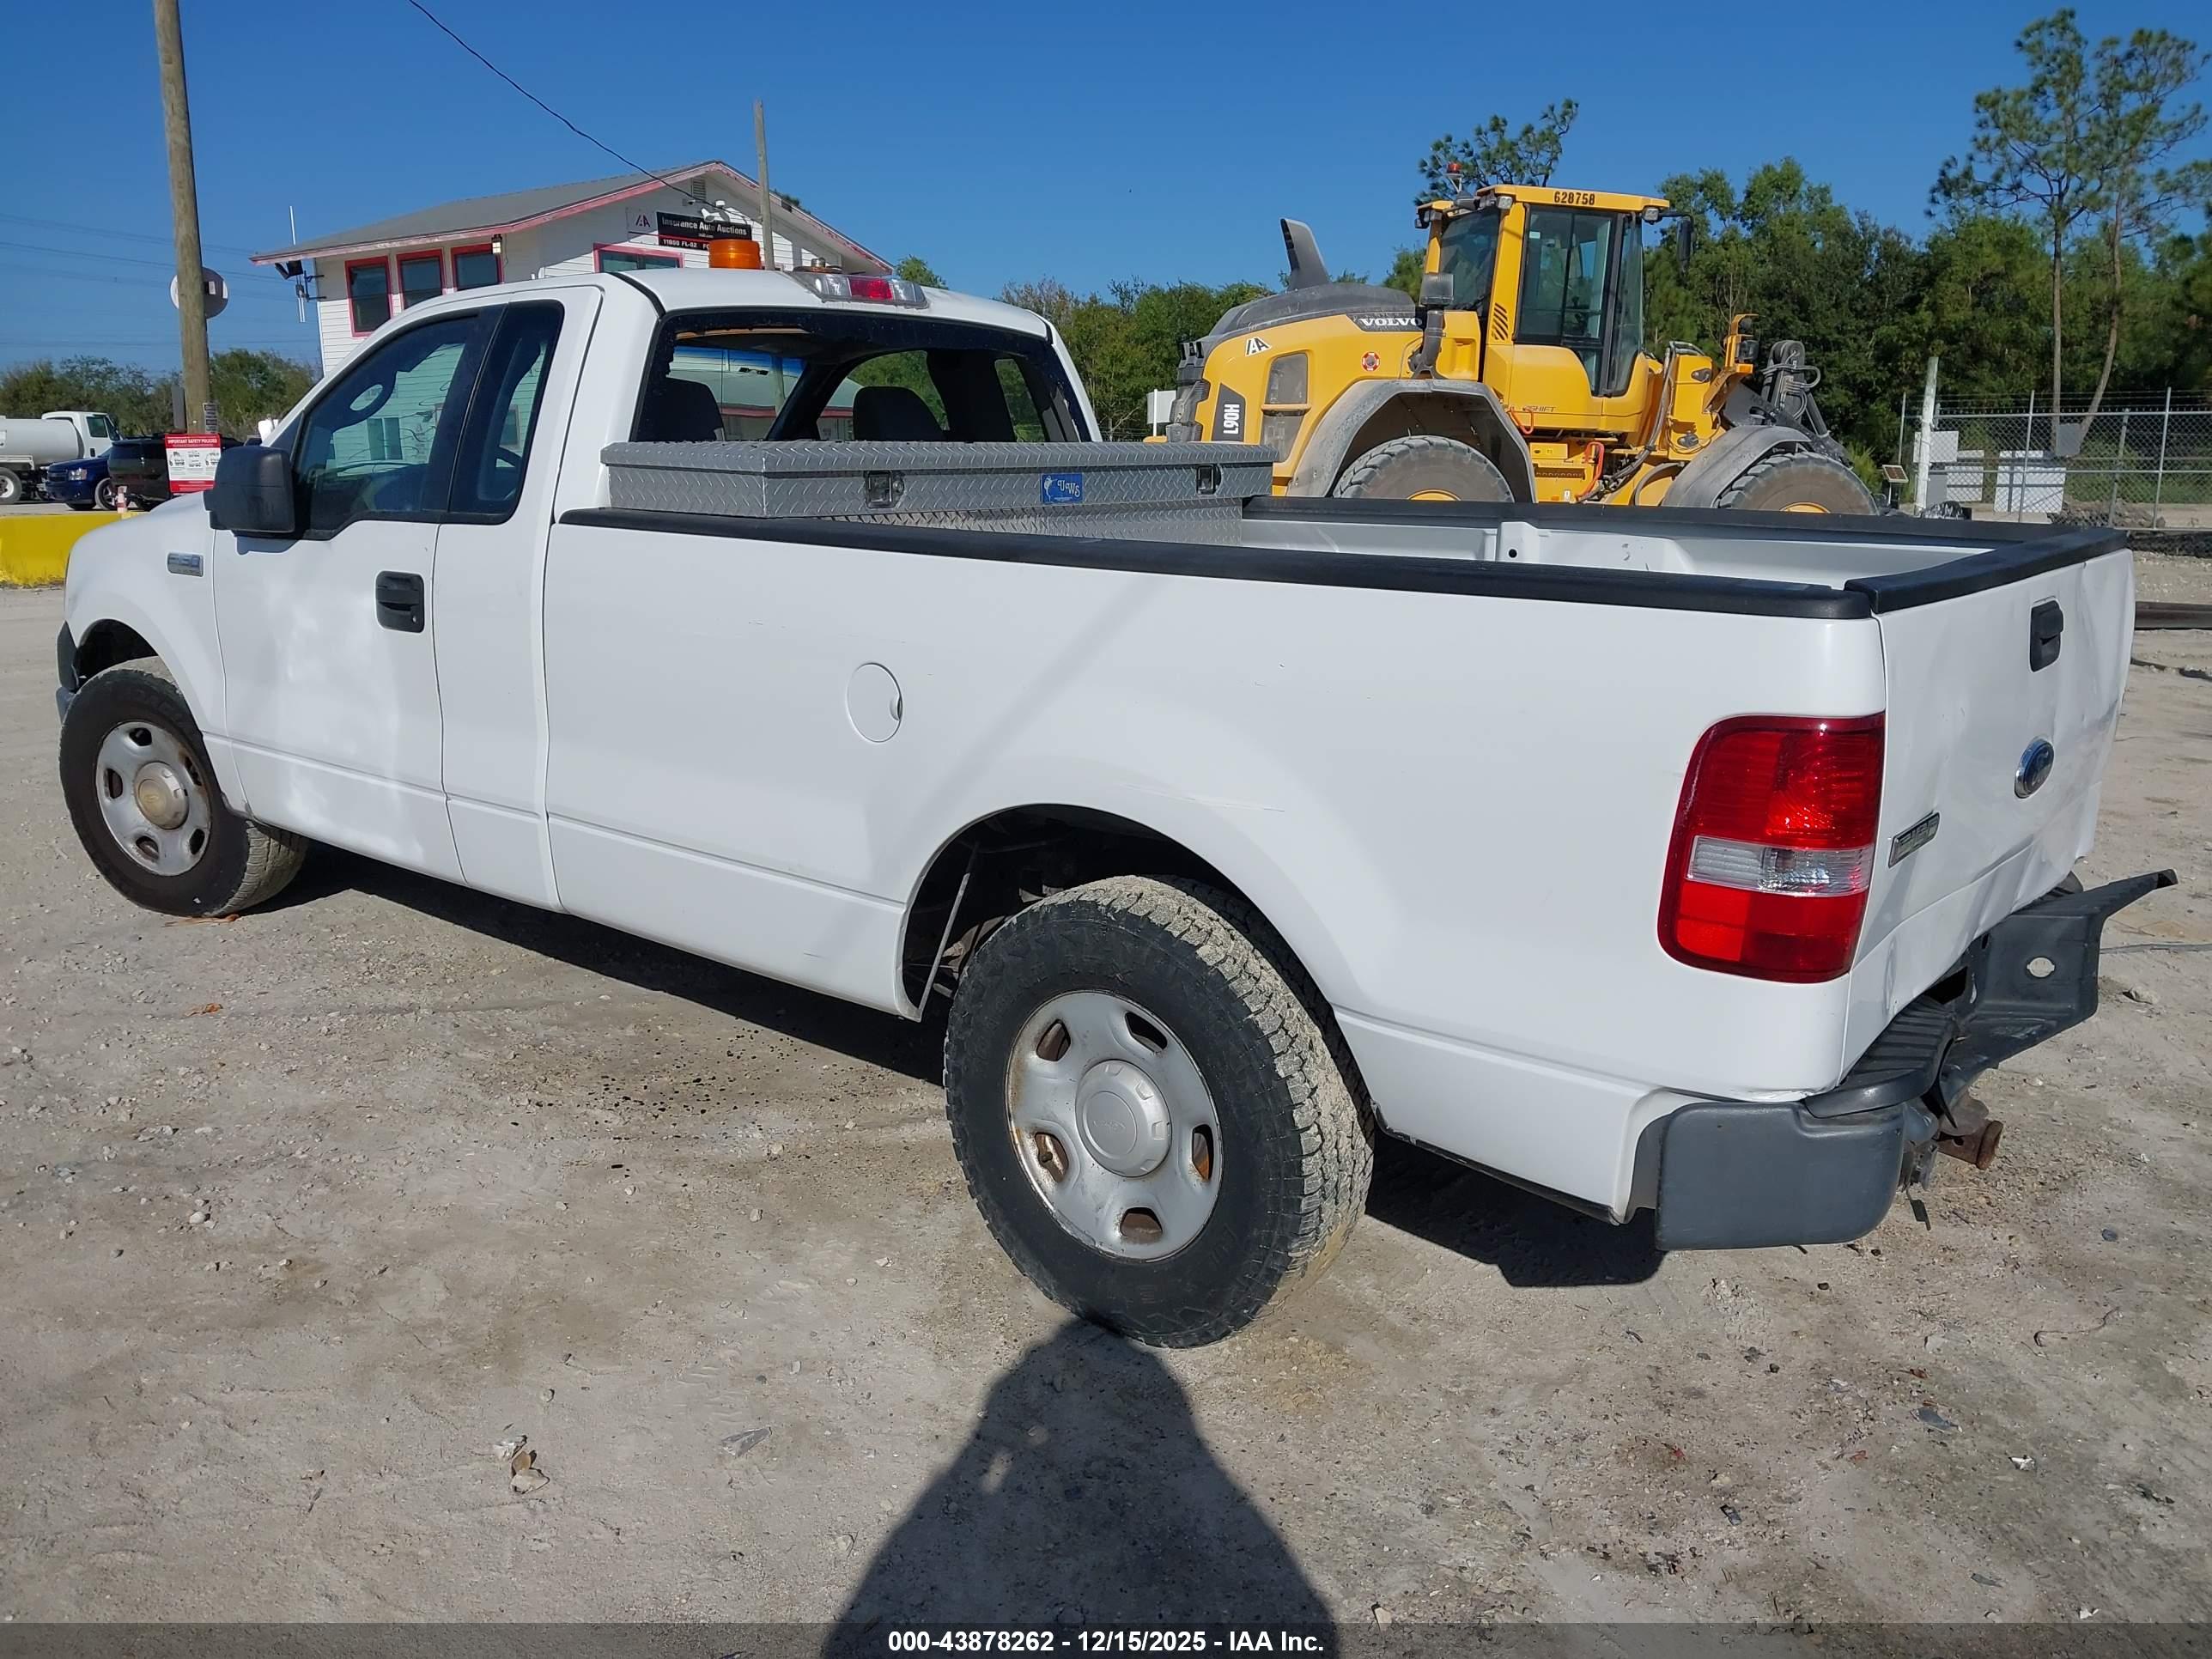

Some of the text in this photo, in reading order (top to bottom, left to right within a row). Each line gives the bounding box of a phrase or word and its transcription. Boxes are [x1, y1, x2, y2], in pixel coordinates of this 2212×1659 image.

[1554, 191, 1595, 205] 628758
[662, 216, 747, 235] Insurance Auto Auctions
[1359, 317, 1423, 326] VOLVO
[1223, 403, 1240, 434] L90H
[1057, 480, 1080, 497] UWS
